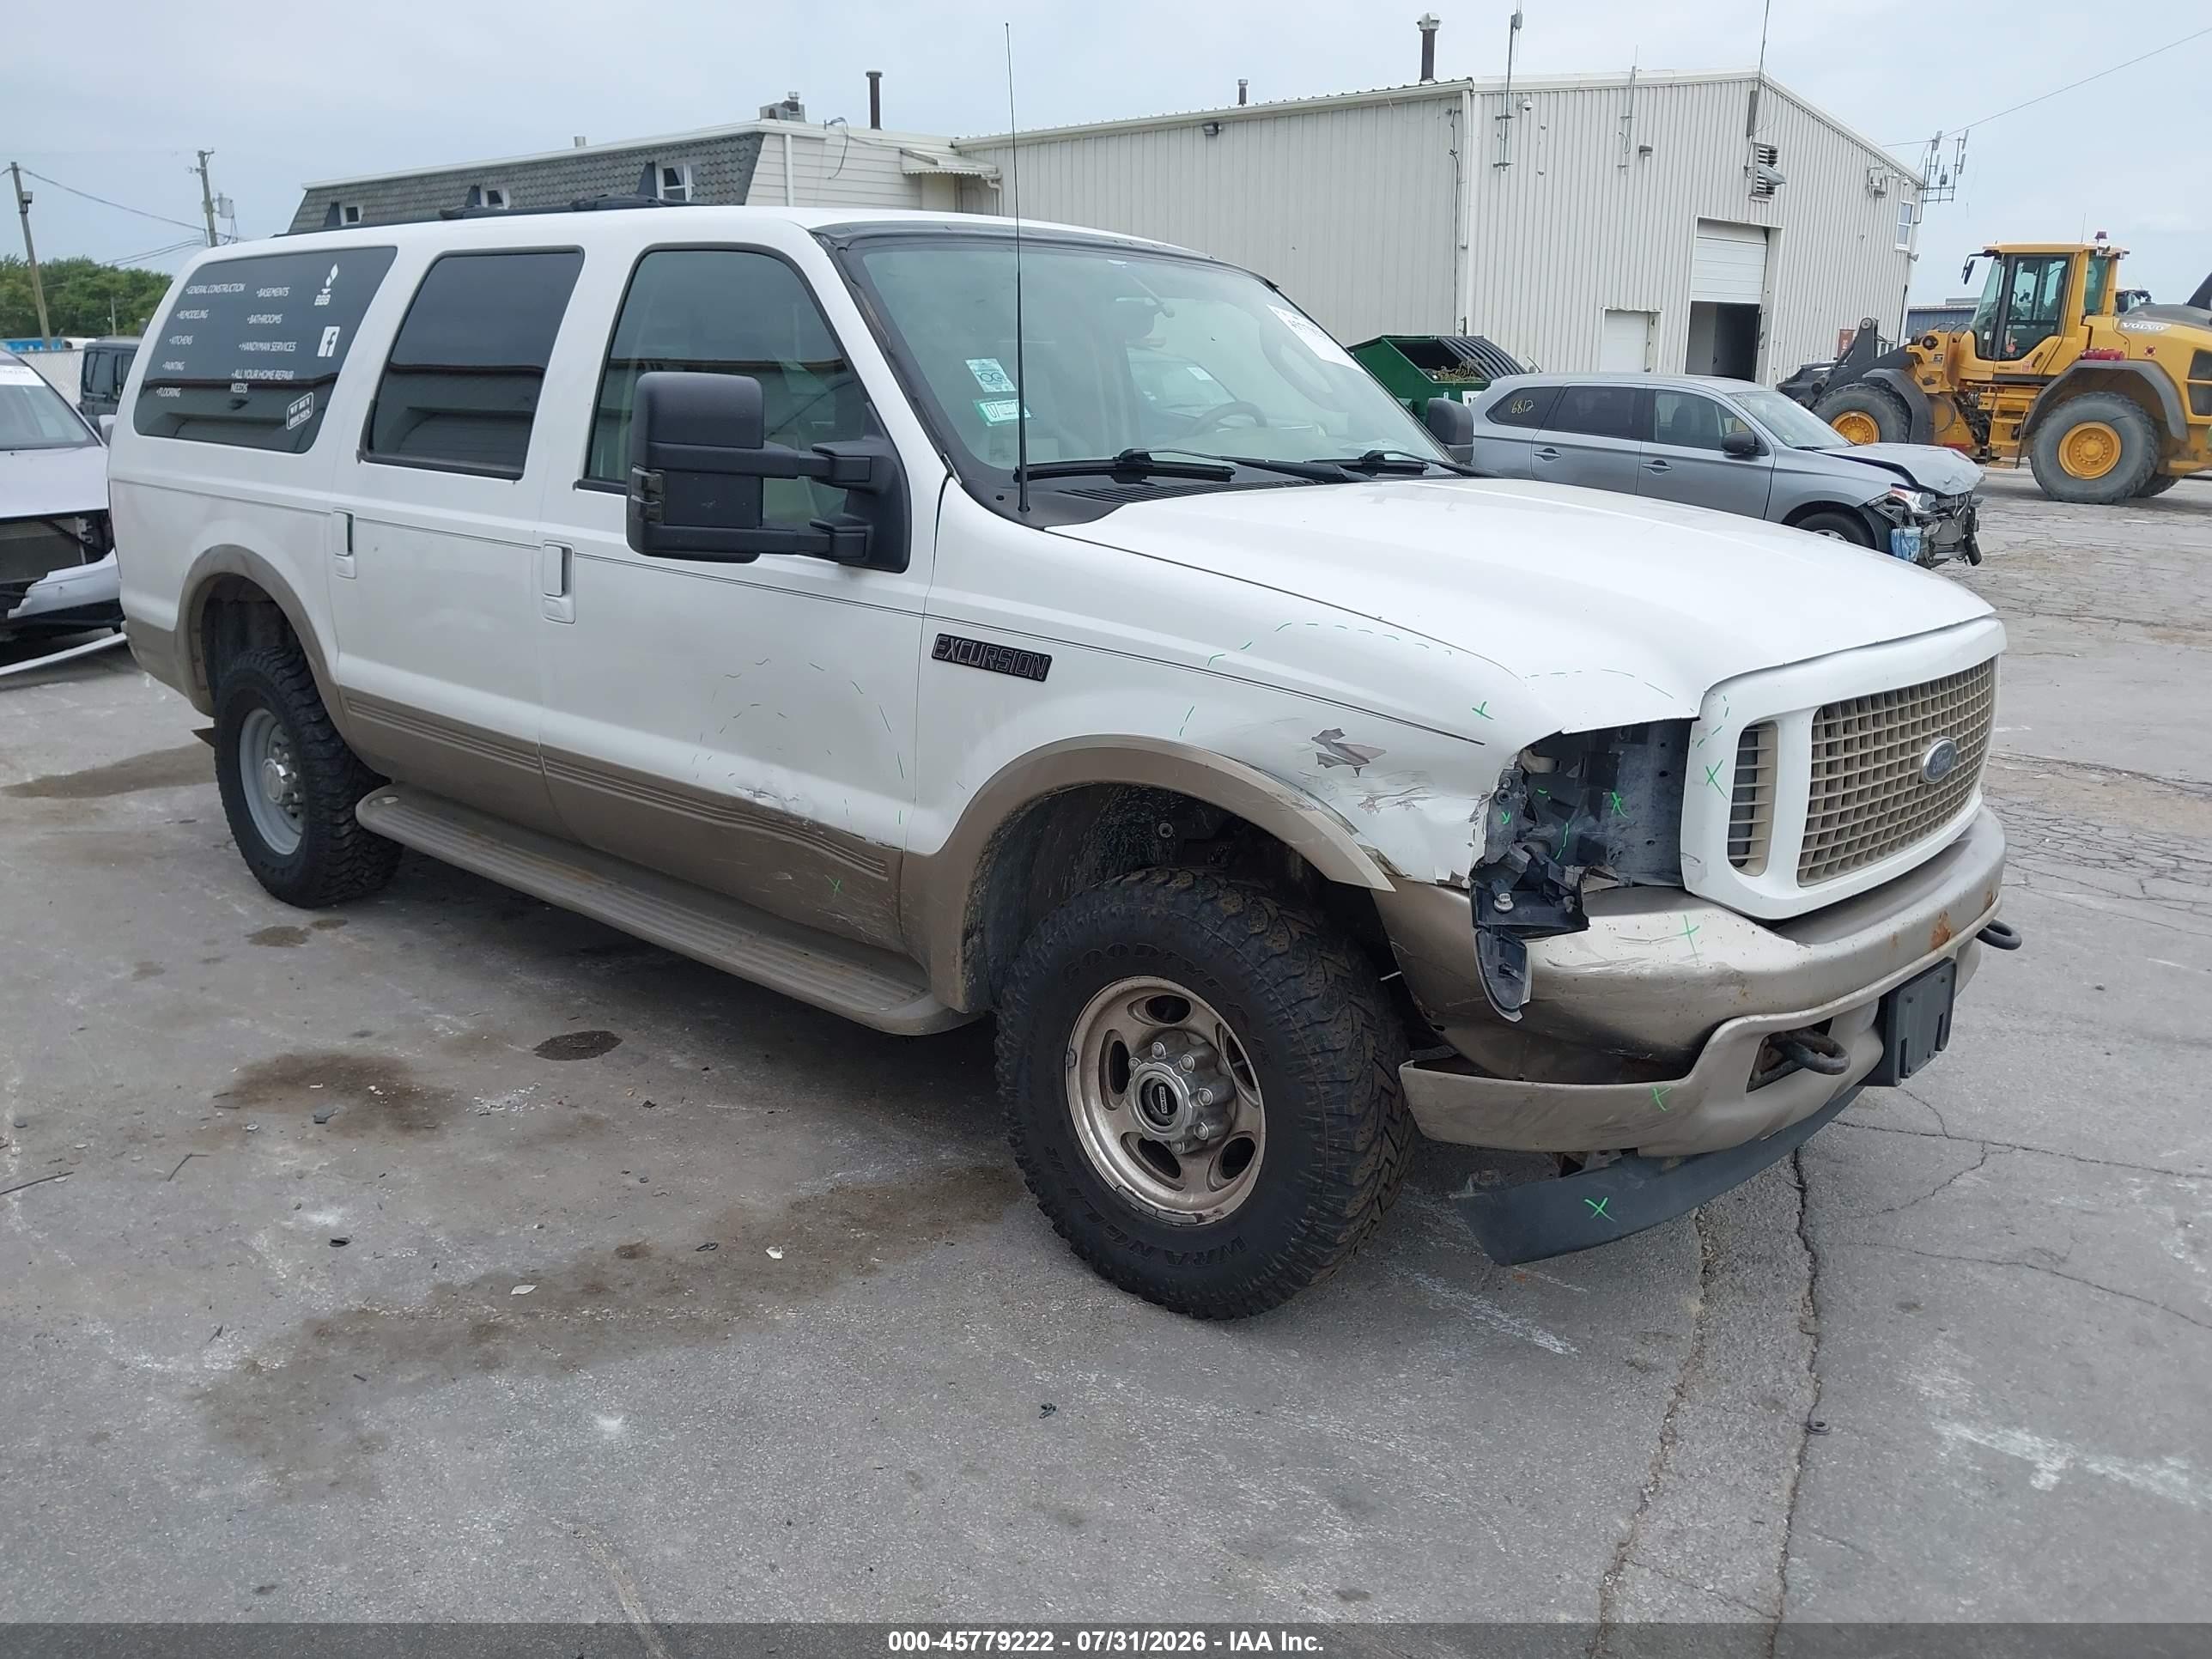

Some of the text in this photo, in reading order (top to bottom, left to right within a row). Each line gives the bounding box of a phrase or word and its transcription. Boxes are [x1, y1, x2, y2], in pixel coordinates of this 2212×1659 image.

[208, 283, 246, 294] CONSTRUCTION
[258, 287, 291, 297] BASEMENTS
[179, 309, 210, 319] REMODELING
[248, 313, 283, 325] BATHROOMS
[2122, 322, 2164, 331] VOLVO
[171, 335, 194, 345] KITCHENS
[241, 341, 297, 352] HANDYMAN SERVICES
[164, 361, 186, 371] PAINTING
[233, 368, 295, 380] ALL YOUR HOME REPAIR
[157, 386, 182, 398] FLOORING
[230, 382, 249, 394] NEEDS
[1511, 399, 1534, 414] 6812
[933, 634, 1049, 680] EXCURSION
[1932, 748, 1953, 774] Ford
